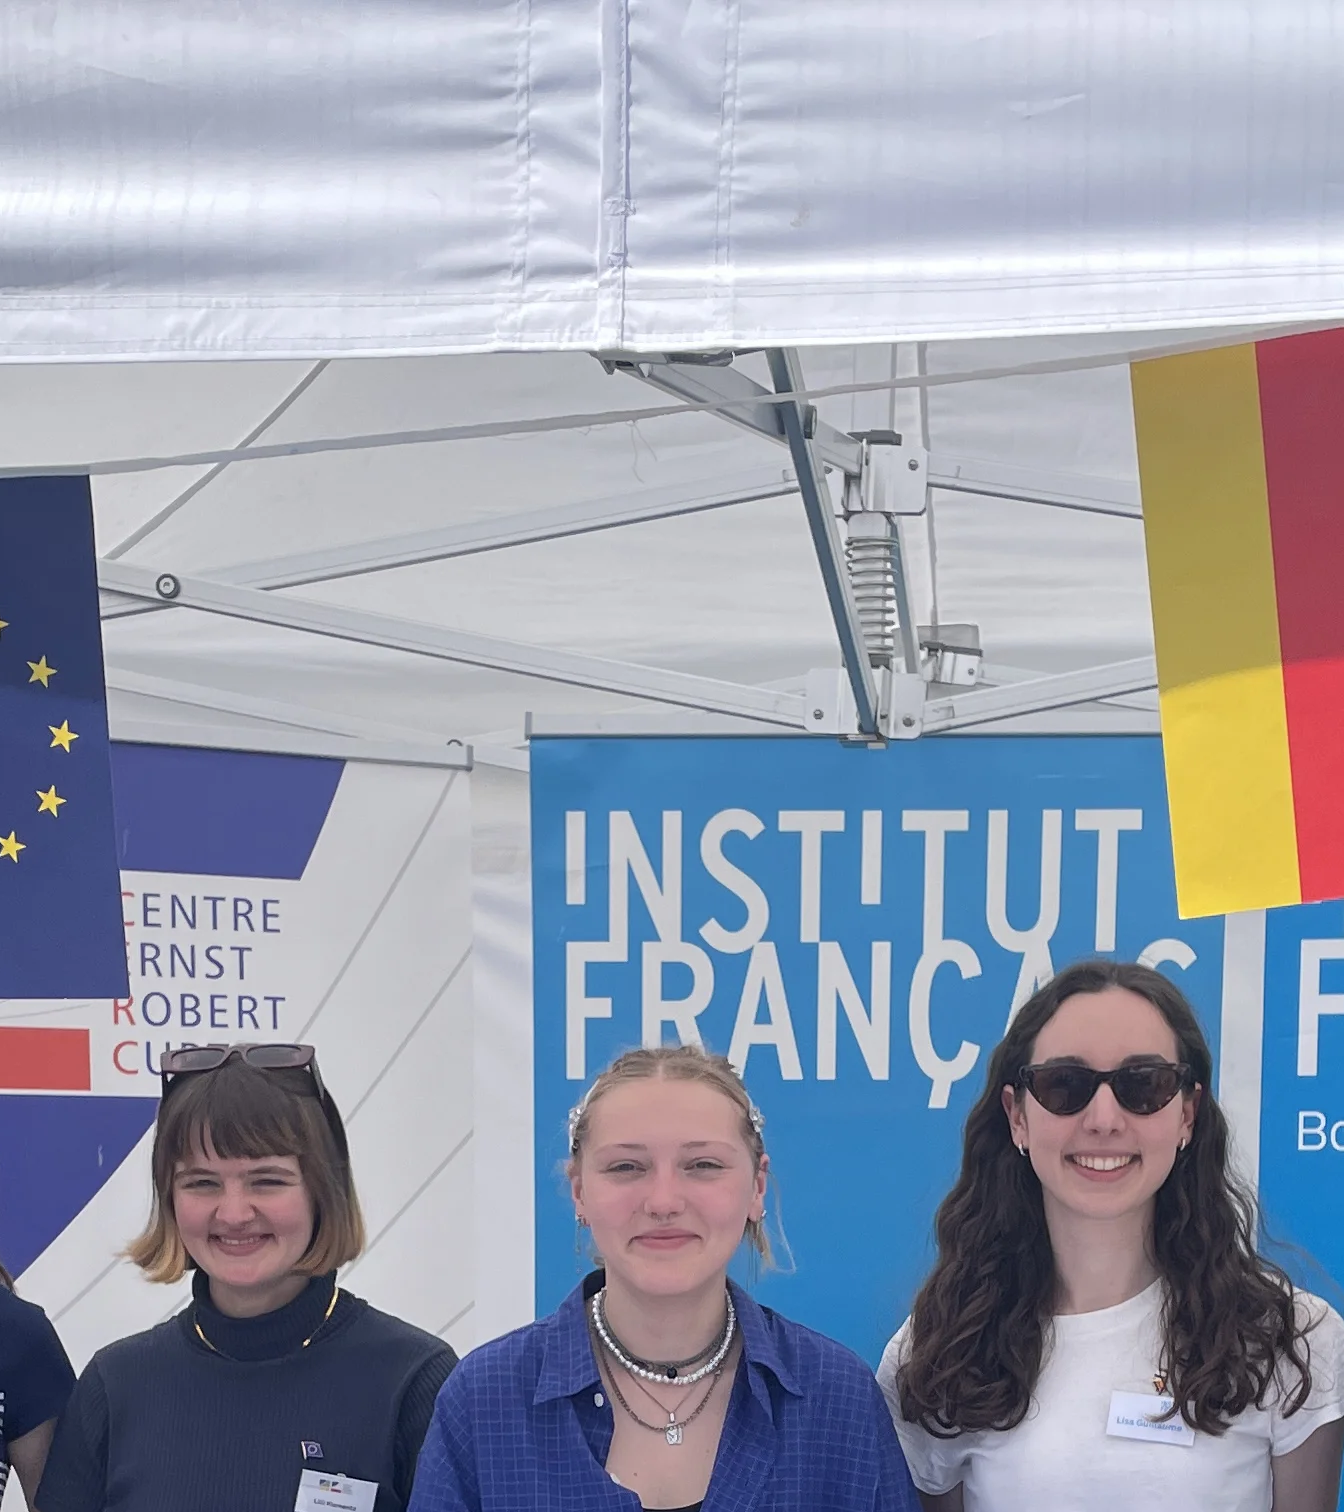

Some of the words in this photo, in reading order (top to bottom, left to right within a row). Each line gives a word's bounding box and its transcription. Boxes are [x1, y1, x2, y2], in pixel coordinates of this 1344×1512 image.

[565, 808, 1143, 953] INSTITUT
[125, 941, 253, 981] RNST
[113, 991, 286, 1030] ROBERT
[565, 938, 1197, 1108] FRANÇ
